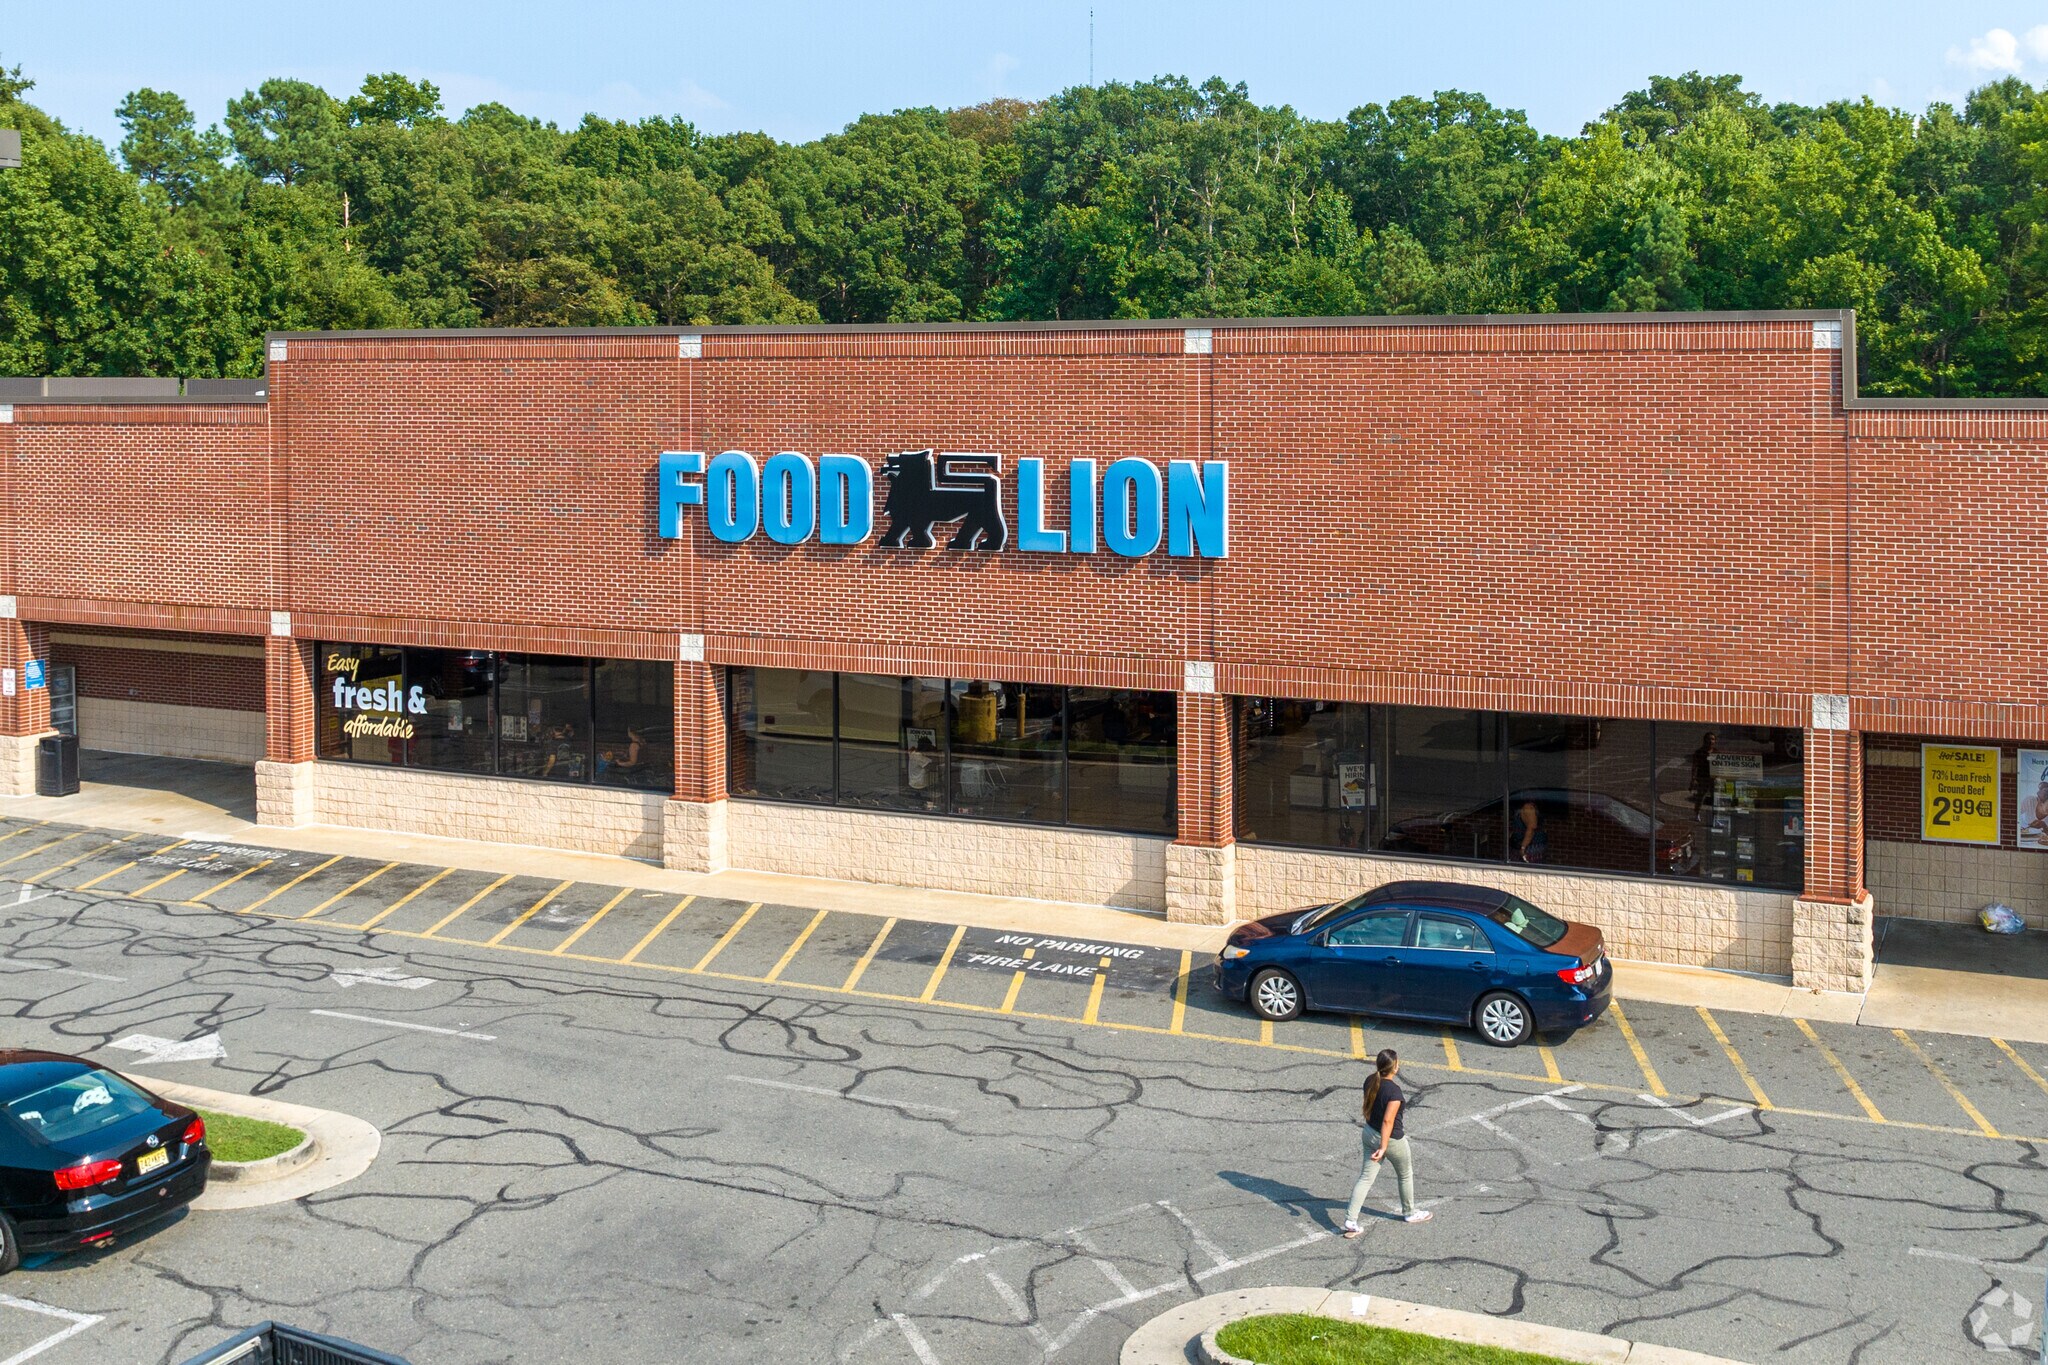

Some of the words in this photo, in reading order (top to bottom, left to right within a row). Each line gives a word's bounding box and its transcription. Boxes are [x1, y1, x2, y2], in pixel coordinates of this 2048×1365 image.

[658, 450, 874, 545] FOOD
[1018, 456, 1229, 559] LION
[327, 653, 360, 682] Easy
[333, 677, 403, 713] fresh
[408, 685, 428, 714] &
[343, 714, 414, 739] affordable
[1955, 752, 1986, 763] SALE!
[1932, 770, 1948, 781] 73%
[1950, 770, 1968, 782] Lean
[1970, 772, 1992, 783] Fresh
[1938, 784, 1965, 794] Ground
[1967, 785, 1985, 796] Beef
[994, 934, 1034, 947] NO
[1035, 938, 1145, 960] PARKING
[968, 954, 1028, 968] FIRE
[1027, 960, 1098, 977] LANE
